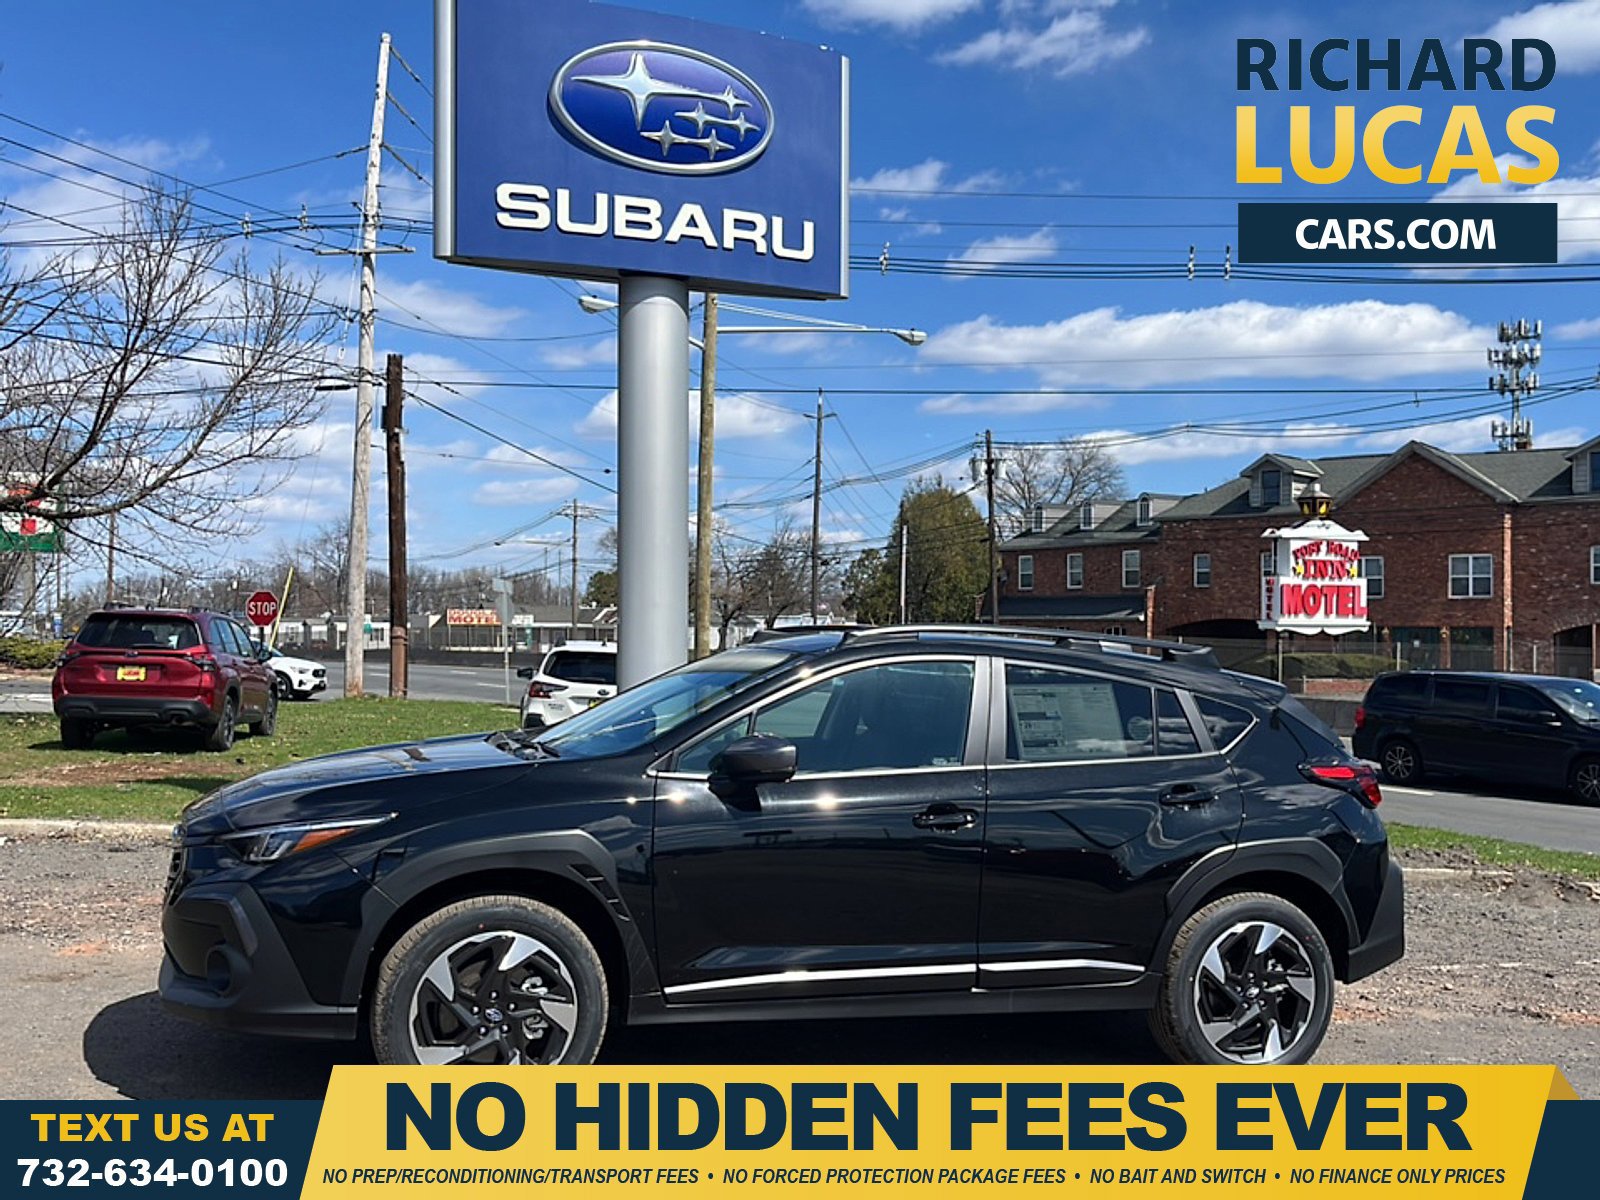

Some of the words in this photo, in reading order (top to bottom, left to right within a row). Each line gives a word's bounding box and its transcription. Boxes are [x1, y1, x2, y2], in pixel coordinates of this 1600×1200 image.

[496, 183, 814, 261] SUBARU
[1292, 540, 1322, 561] POST
[1327, 540, 1361, 563] ROAD
[1302, 559, 1347, 581] INN
[248, 601, 277, 616] STOP
[1281, 583, 1368, 617] MOTEL
[449, 614, 500, 625] MOTEL
